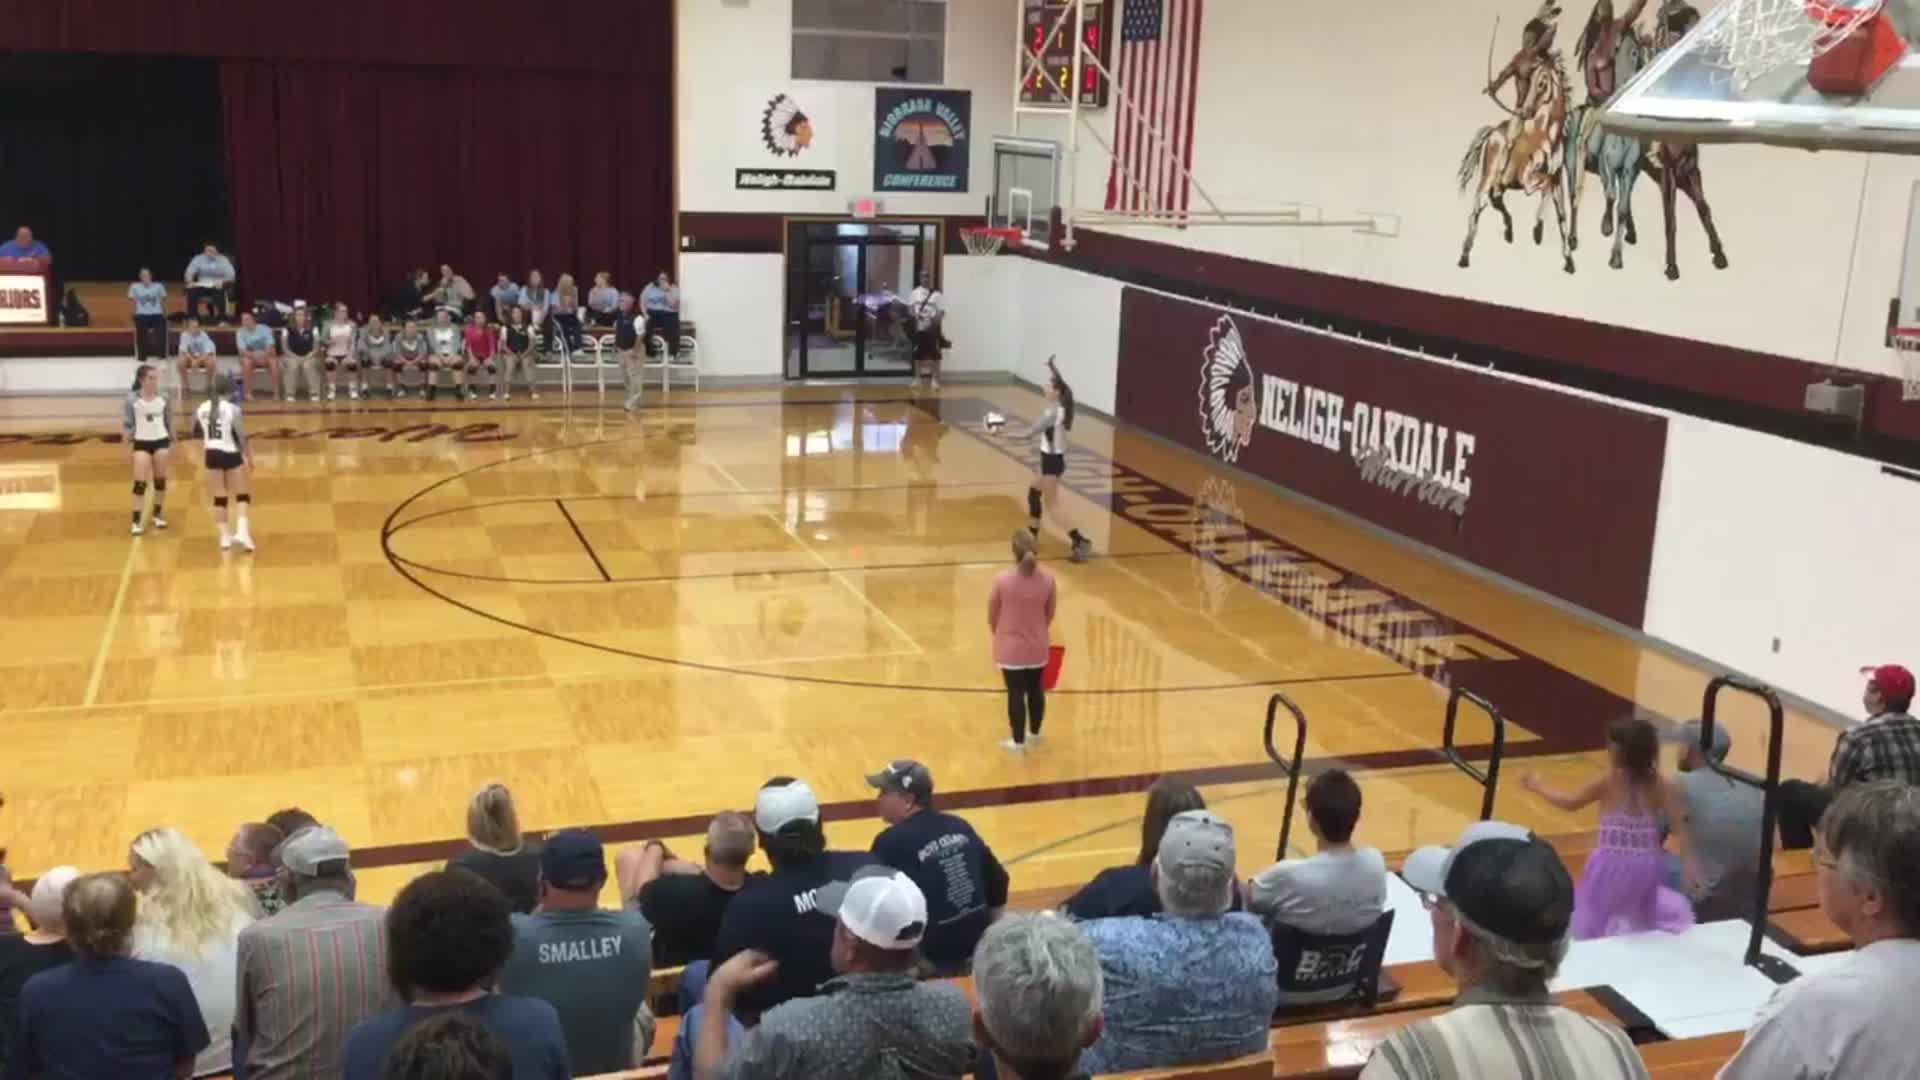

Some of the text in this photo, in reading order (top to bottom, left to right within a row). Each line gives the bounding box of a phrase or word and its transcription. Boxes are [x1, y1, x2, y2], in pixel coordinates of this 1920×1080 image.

[883, 173, 957, 187] CONFERENCE
[1259, 373, 1476, 497] NELIGH-OAKDALE
[538, 935, 622, 963] SMALLEY
